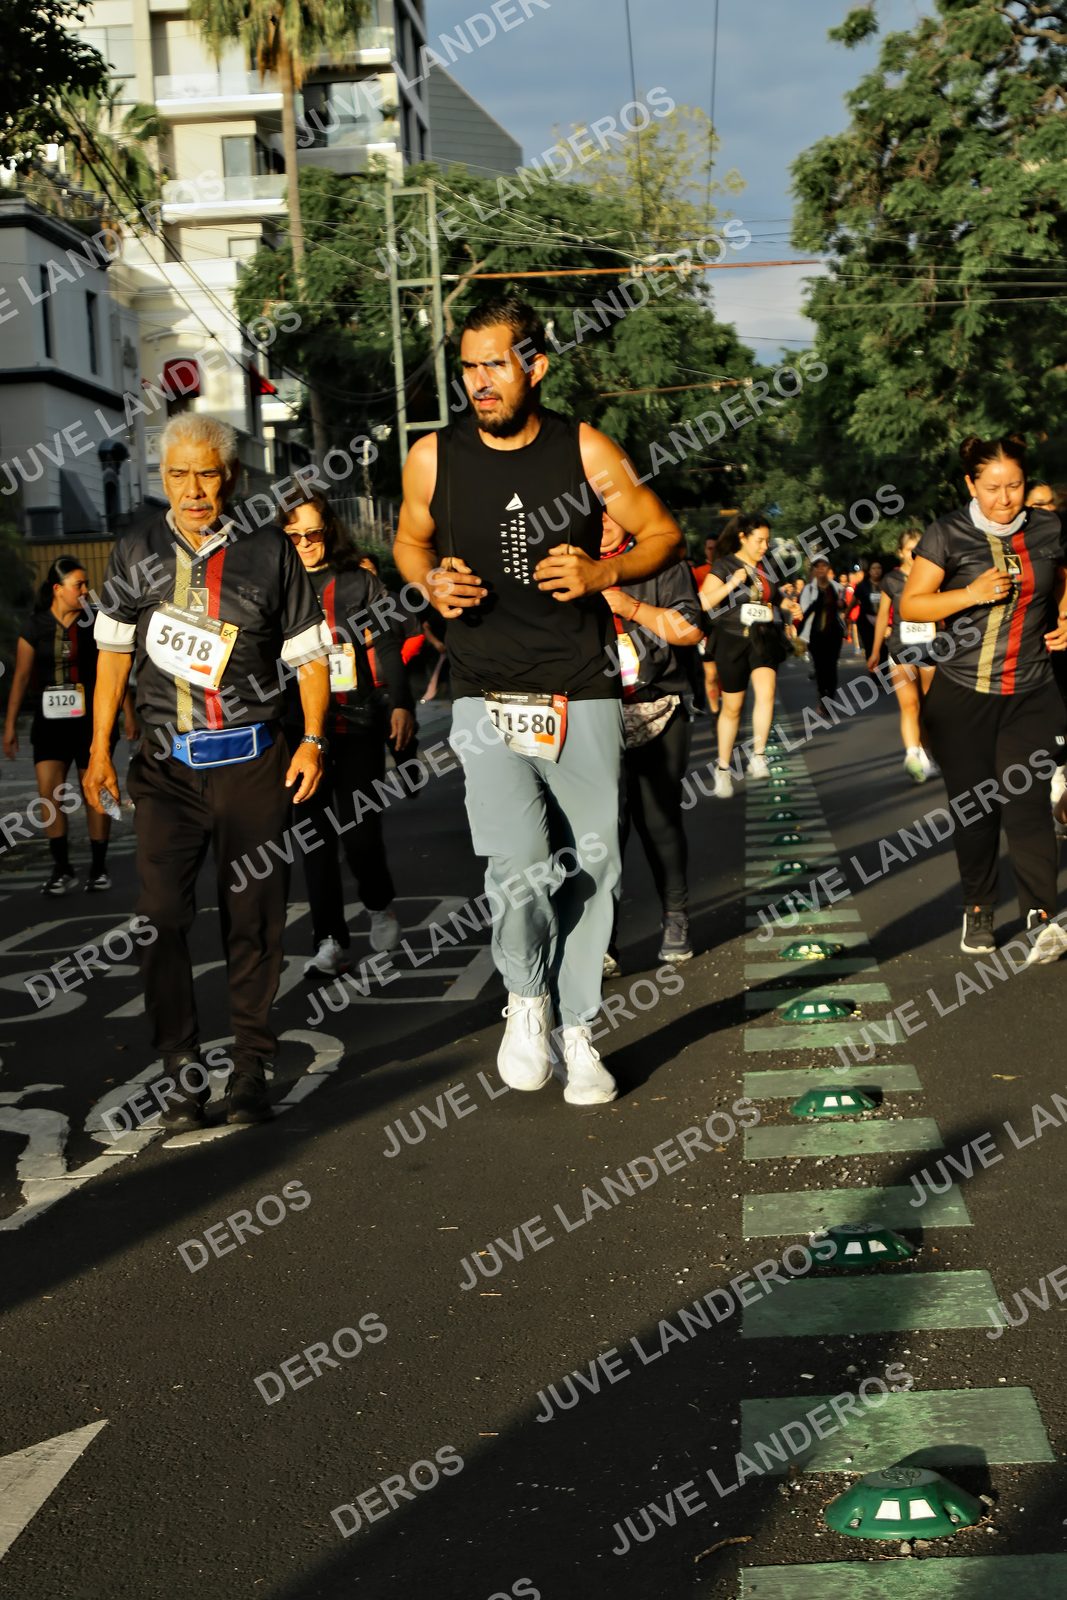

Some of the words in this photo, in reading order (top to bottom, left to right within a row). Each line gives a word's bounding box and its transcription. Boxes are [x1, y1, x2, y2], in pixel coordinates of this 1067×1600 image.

[500, 523, 511, 574] INIZIO
[521, 558, 530, 585] THAN
[156, 624, 213, 662] 5618
[48, 694, 76, 707] 3120
[491, 708, 556, 736] 11580
